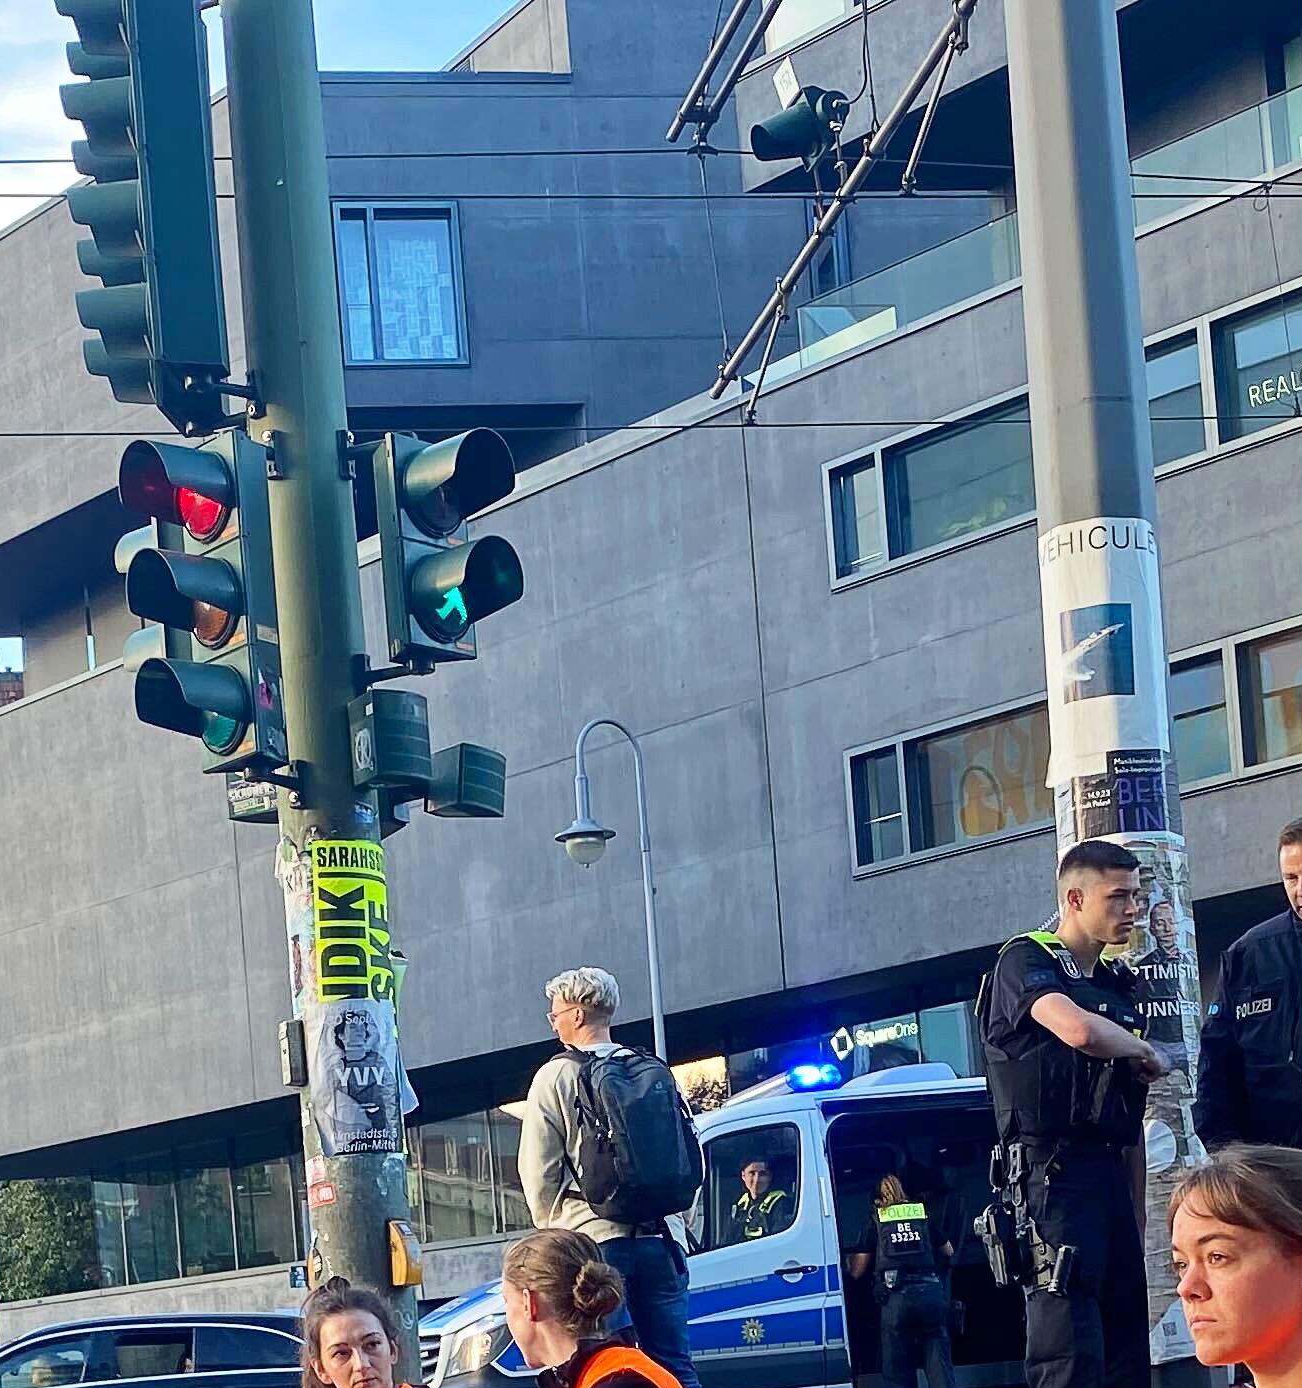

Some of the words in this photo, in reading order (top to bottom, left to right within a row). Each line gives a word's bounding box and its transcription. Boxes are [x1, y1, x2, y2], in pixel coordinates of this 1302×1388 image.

[1131, 963, 1198, 981] PTIMISTI
[1134, 1001, 1200, 1018] UNNERS
[1236, 997, 1272, 1019] POLIZEI
[855, 1022, 918, 1048] SquareOne
[335, 1066, 385, 1087] YVY
[879, 1205, 923, 1219] POLIZEI
[897, 1222, 911, 1232] BE
